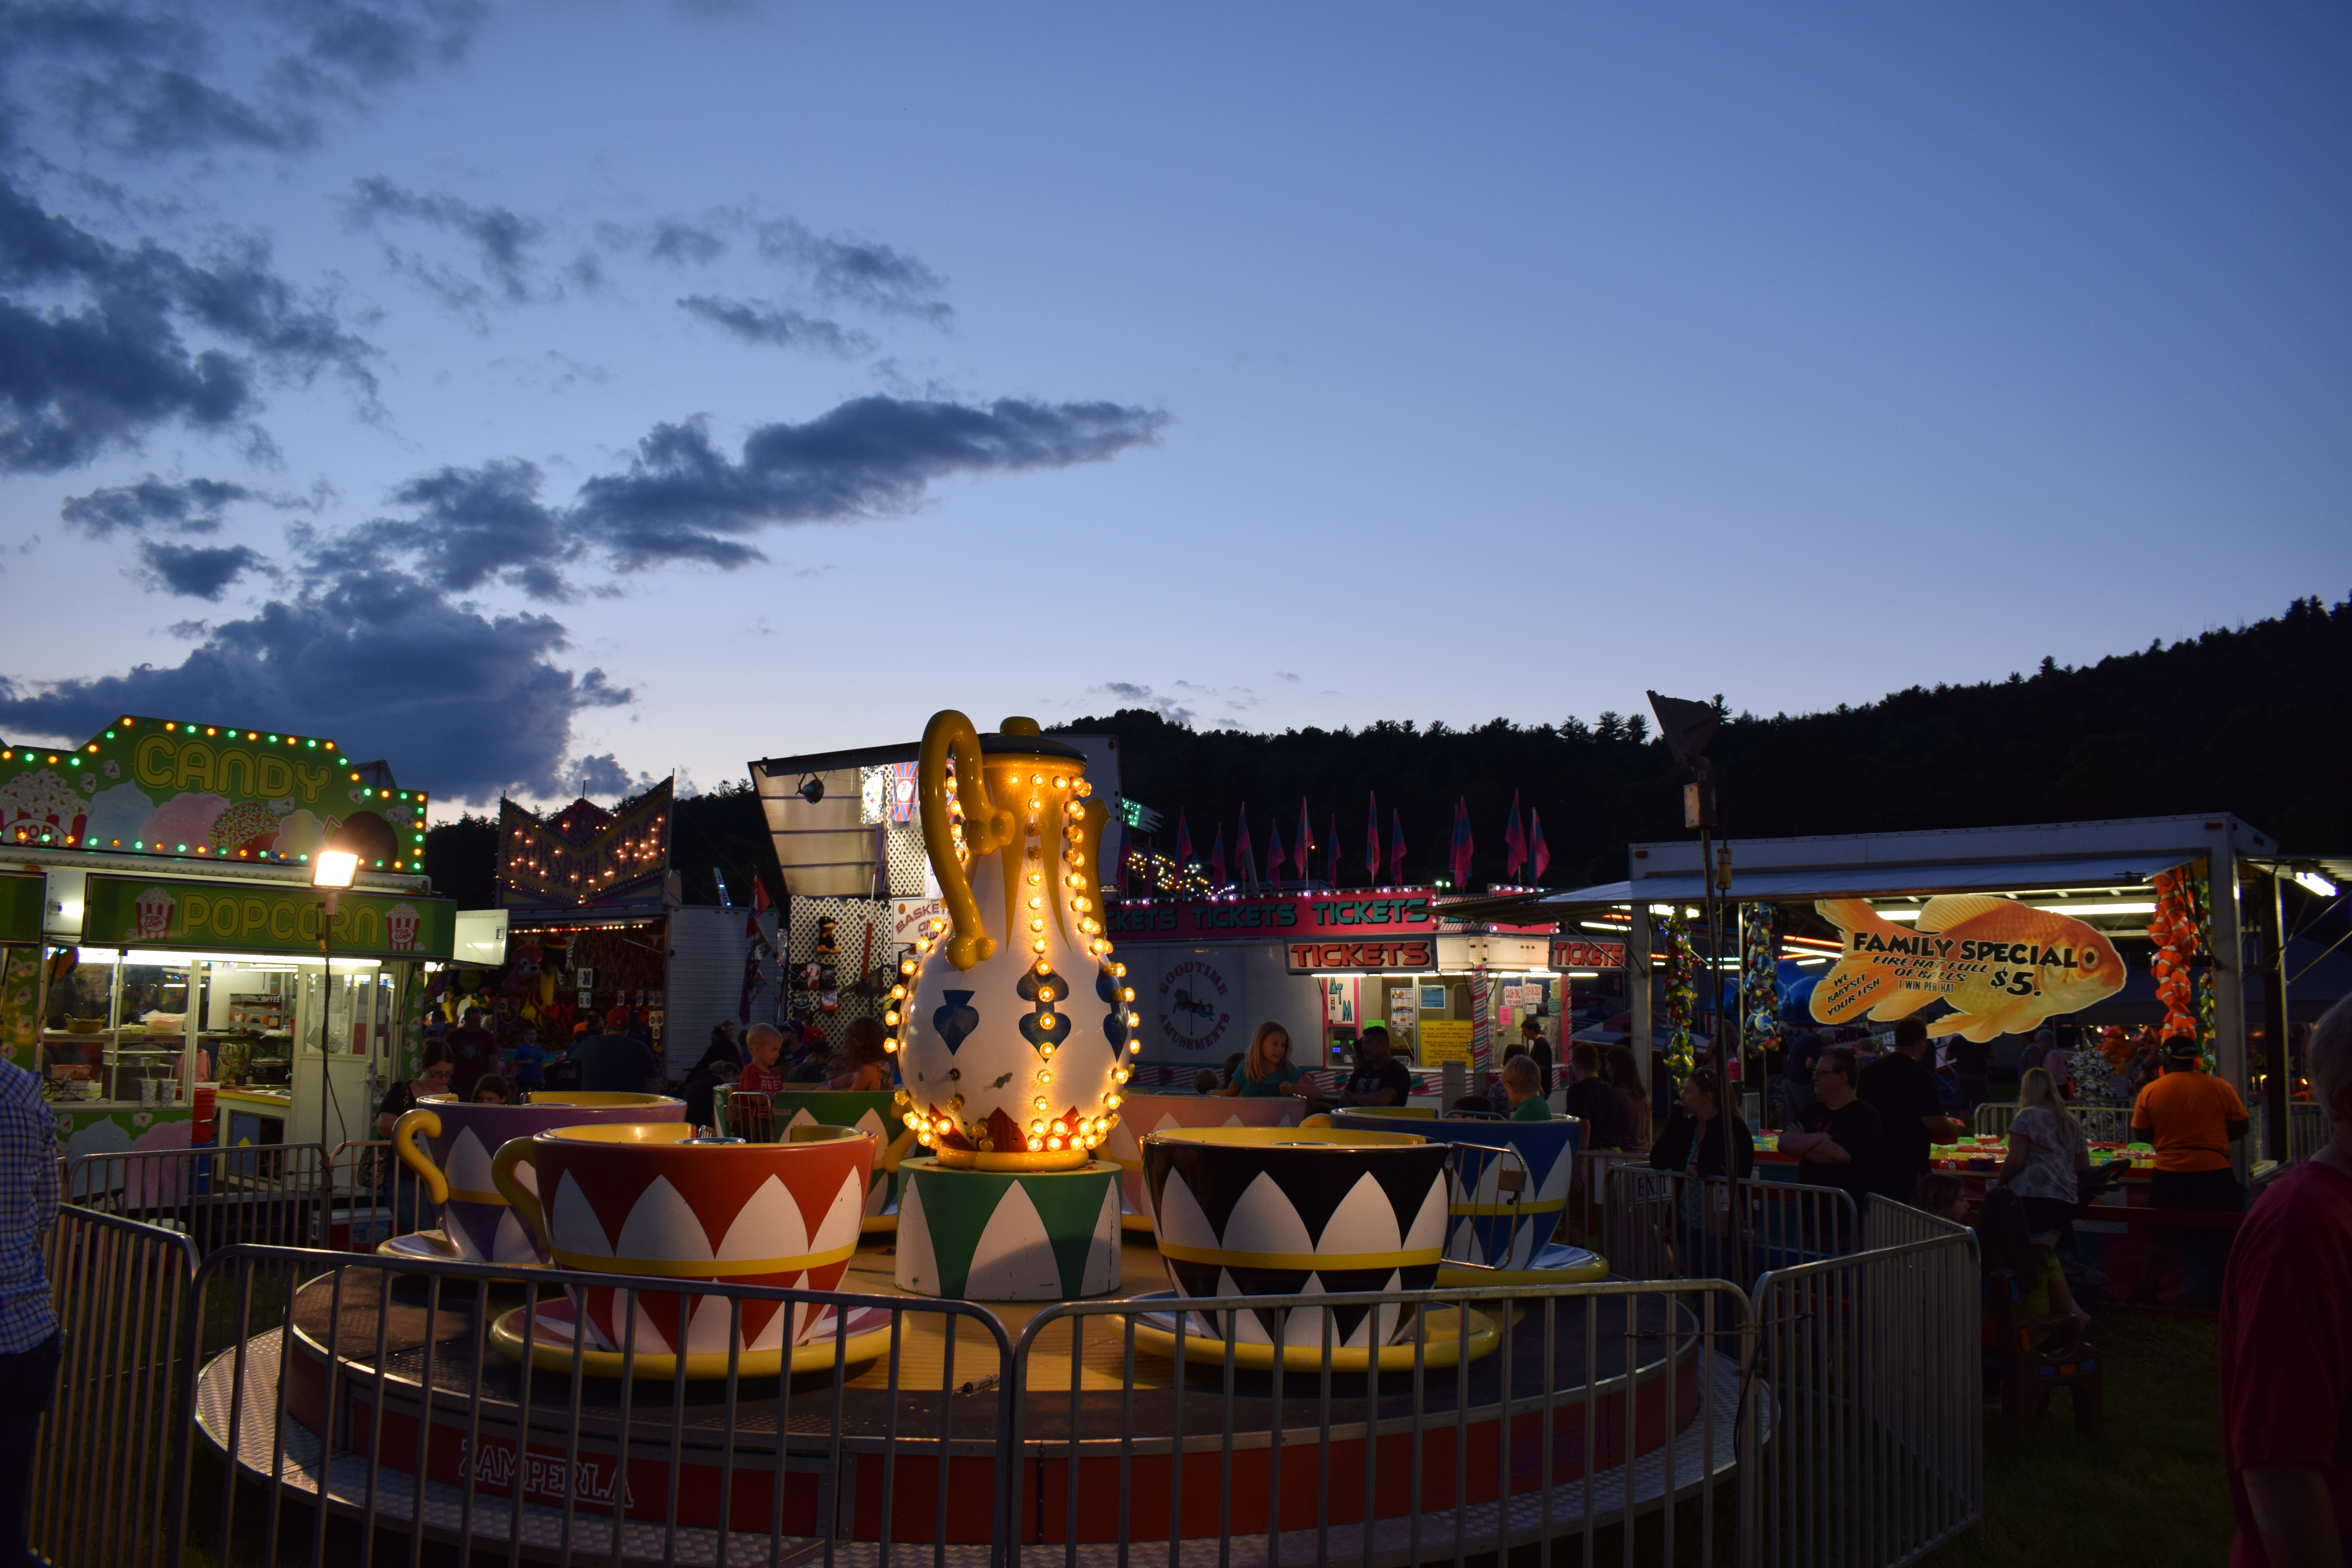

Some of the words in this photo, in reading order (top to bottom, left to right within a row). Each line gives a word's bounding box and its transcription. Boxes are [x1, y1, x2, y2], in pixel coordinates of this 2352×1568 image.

[134, 733, 331, 803] CANDY
[505, 822, 598, 891] CROSSBOW
[181, 893, 381, 945] POPCORN
[1105, 908, 1178, 932] CKETS
[1191, 903, 1297, 929] TICKETS
[1312, 898, 1429, 926] TICKETS
[1290, 942, 1430, 967] TICKETS
[1553, 942, 1625, 966] TICKETS
[1853, 932, 1955, 958] FAMILY
[1960, 940, 2078, 968] SPECIAL
[1873, 956, 1911, 967] FIRE
[1912, 959, 1947, 969] HAT
[1947, 962, 1989, 973] FULL
[1159, 961, 1228, 996] GOODTIME
[1828, 972, 1867, 1003] BABYSIT
[1834, 973, 1849, 987] WE
[1894, 968, 1916, 977] OF
[1917, 970, 1968, 982] BALLS
[1899, 980, 1902, 989] 1
[1906, 980, 1920, 990] WIN
[1924, 982, 1937, 992] PER
[1941, 983, 1955, 993] HAT
[1990, 967, 2042, 996] $5.
[1827, 995, 1856, 1016] YOUR
[1858, 978, 1880, 997] FISH
[1159, 1013, 1230, 1050] AMUSEMENTS
[1637, 1176, 1668, 1196] EXT
